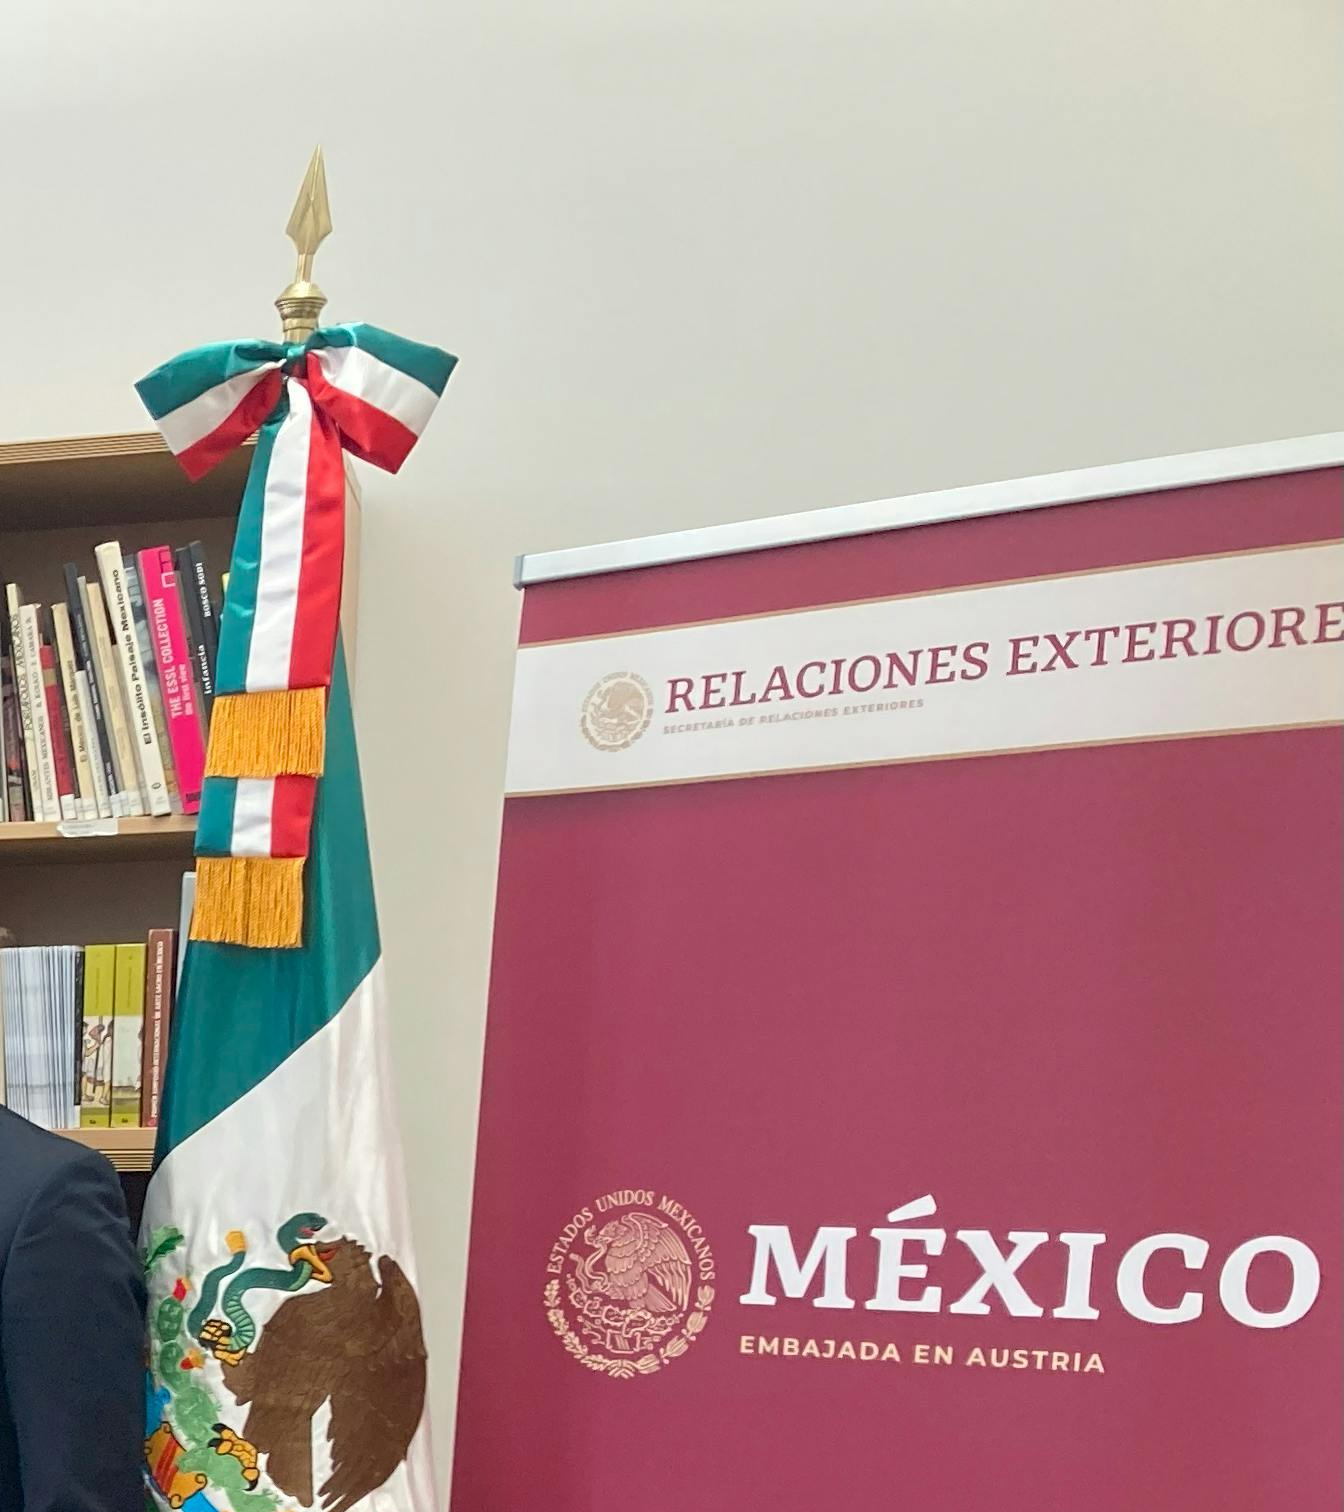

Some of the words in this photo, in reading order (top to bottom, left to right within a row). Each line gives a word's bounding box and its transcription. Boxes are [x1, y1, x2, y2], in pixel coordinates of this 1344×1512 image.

[112, 569, 129, 632] Mexicano
[124, 634, 139, 681] Paisaje
[153, 598, 174, 664] COLLECTION
[664, 641, 990, 713] RELACIONES
[1006, 601, 1344, 676] EXTERIORE
[163, 665, 179, 694] ESSL
[169, 696, 183, 718] THE
[663, 717, 734, 734] SECRETARÍA
[739, 716, 754, 727] DE
[759, 707, 839, 724] RELACIONES
[843, 699, 924, 716] EXTERIORES
[547, 1207, 593, 1274] ESTADOS
[596, 1189, 654, 1212] UNIDOS
[657, 1196, 715, 1281] MEXICANOS
[740, 1194, 1320, 1328] MÉXICO
[739, 1335, 901, 1363] EMBAJADA
[914, 1345, 954, 1365] EN
[966, 1347, 1105, 1374] AUSTRIA
